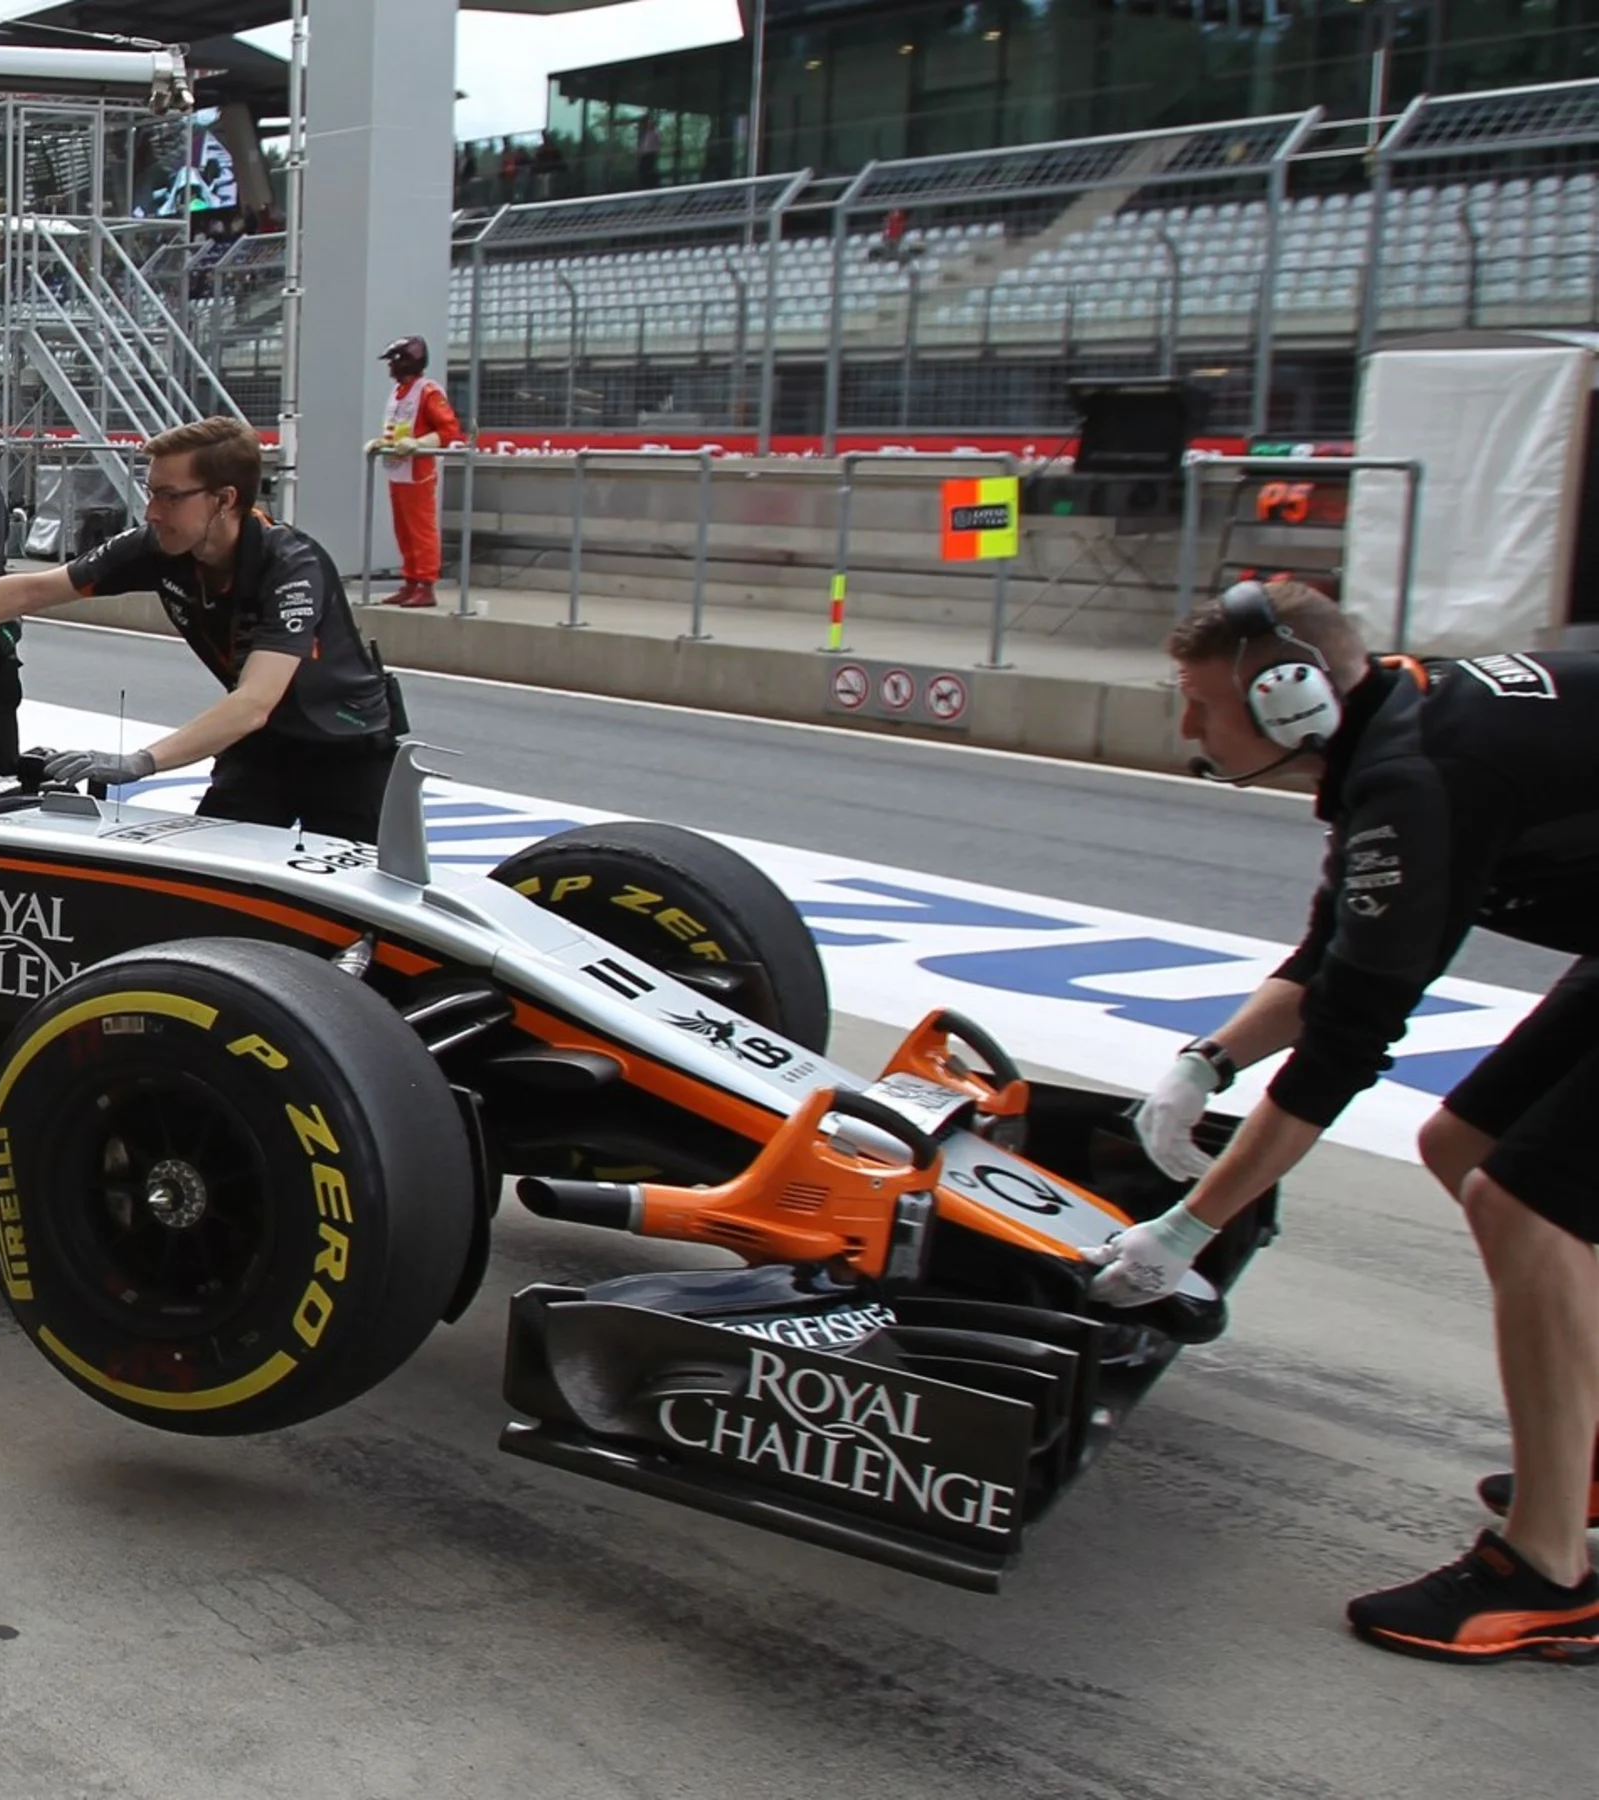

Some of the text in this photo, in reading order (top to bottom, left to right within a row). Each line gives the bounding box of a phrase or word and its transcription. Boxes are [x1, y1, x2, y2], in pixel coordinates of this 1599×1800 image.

[551, 875, 592, 901] P
[226, 1034, 353, 1348] P ZERO
[744, 1347, 932, 1443] ROYAL
[659, 1398, 1014, 1534] CHALLENGE
